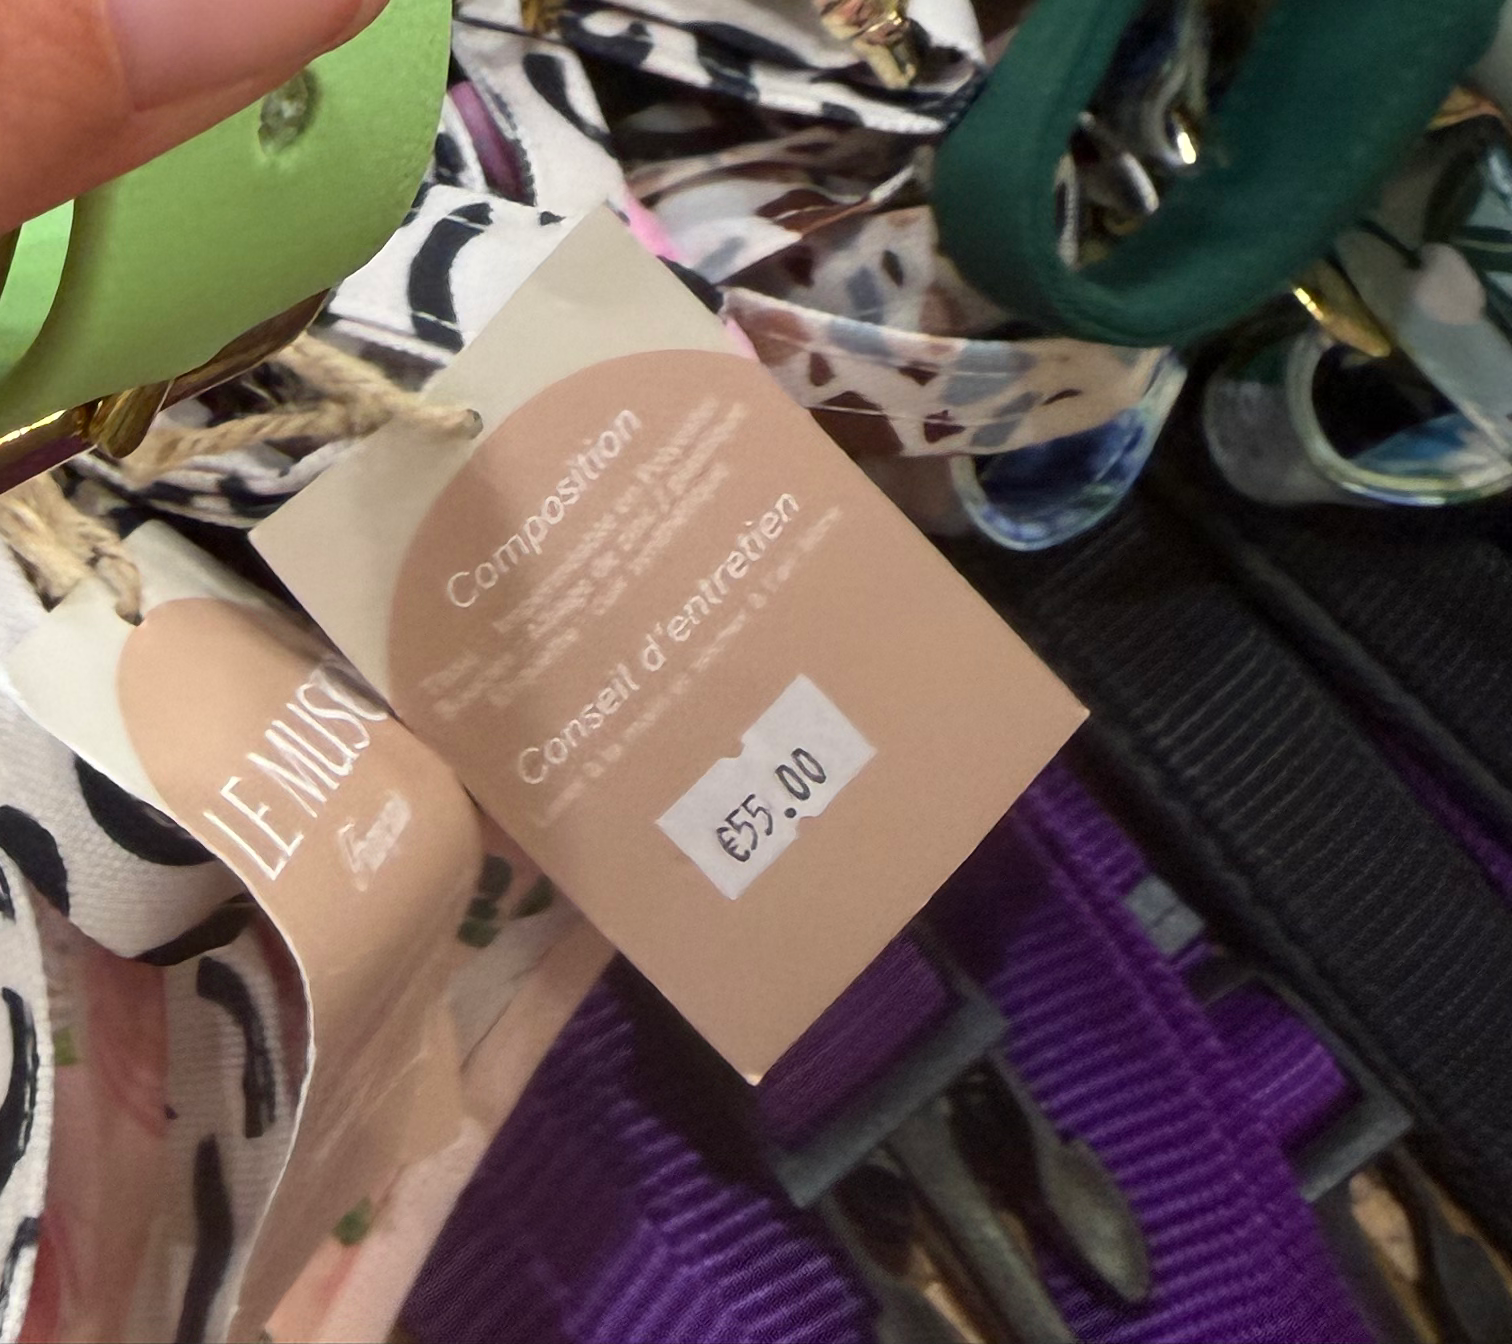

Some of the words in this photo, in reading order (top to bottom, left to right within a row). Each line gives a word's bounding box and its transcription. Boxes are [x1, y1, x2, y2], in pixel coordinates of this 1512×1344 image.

[447, 409, 642, 608] Composition
[519, 663, 640, 784] Conseil
[641, 493, 800, 672] d'entretien
[202, 776, 305, 881] LE
[716, 747, 827, 863] €55.00
